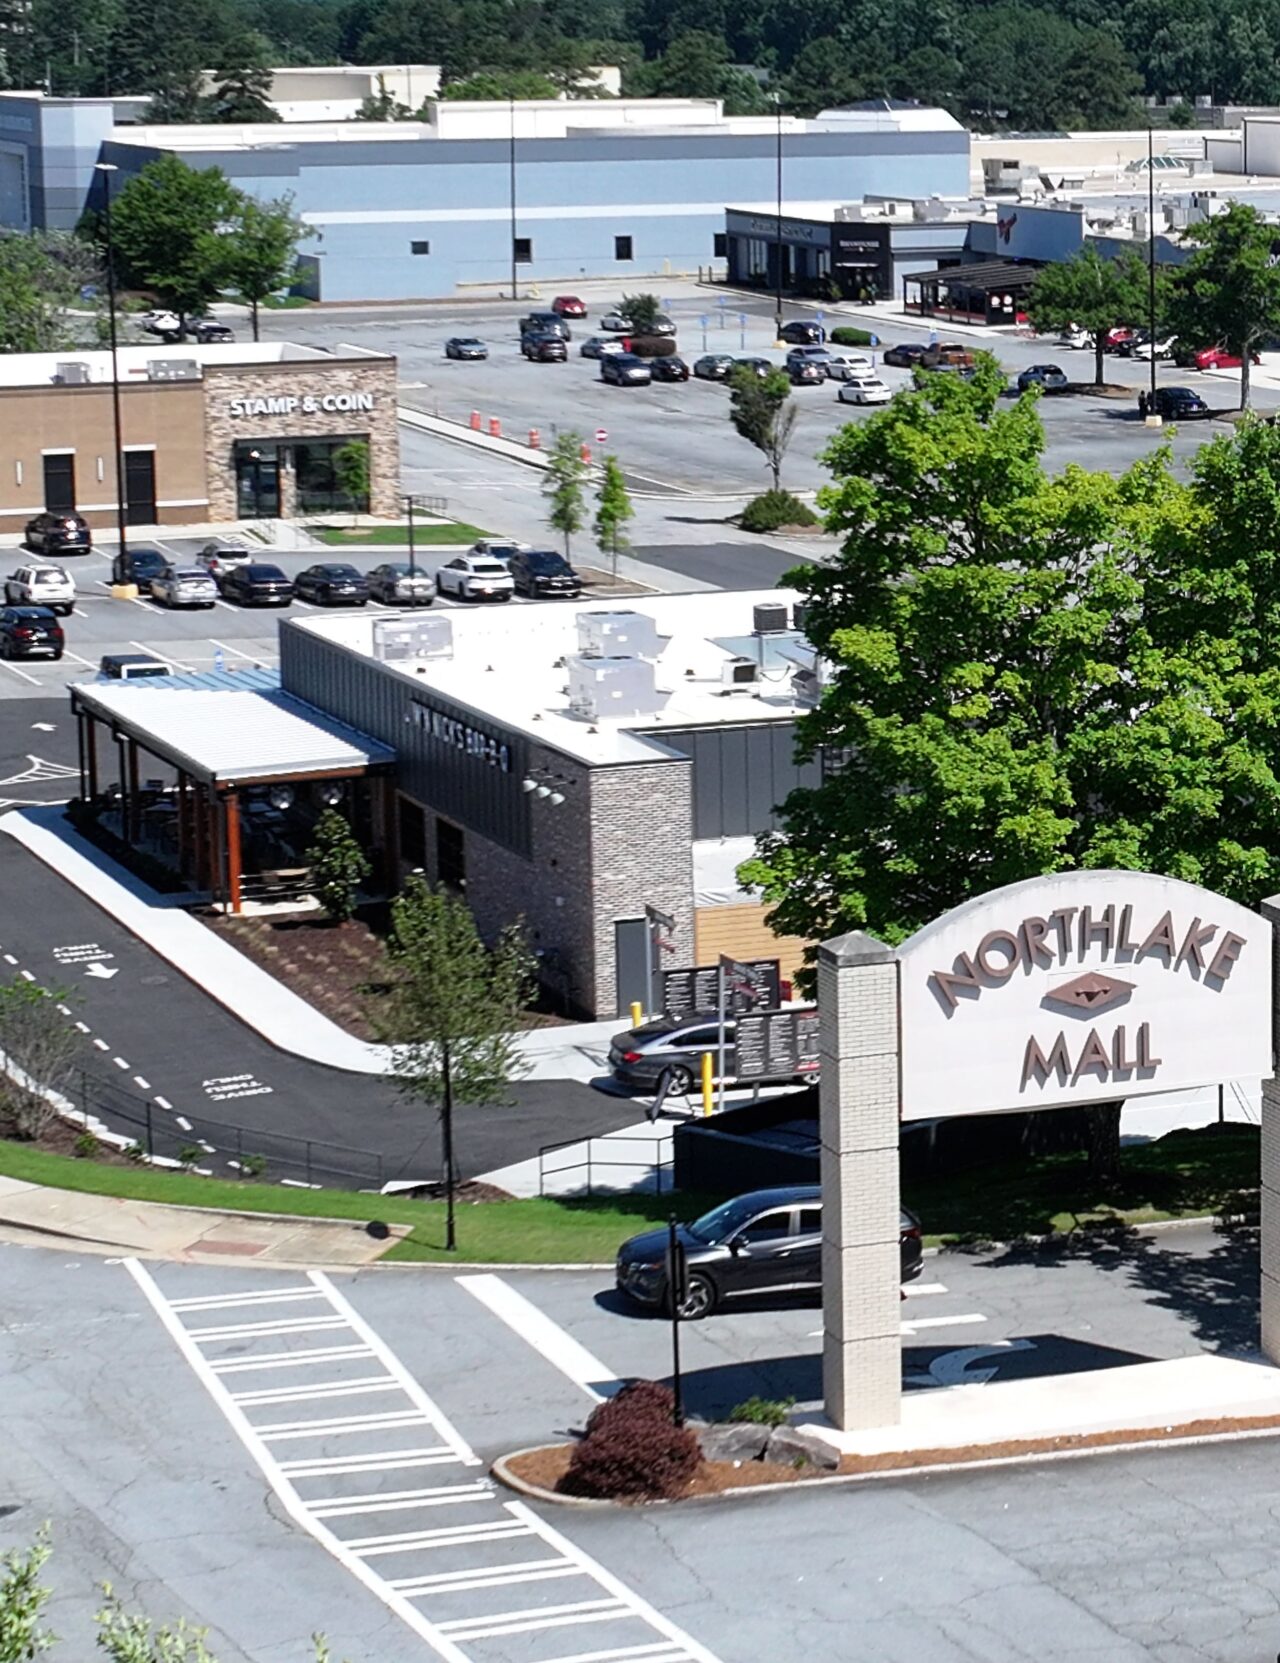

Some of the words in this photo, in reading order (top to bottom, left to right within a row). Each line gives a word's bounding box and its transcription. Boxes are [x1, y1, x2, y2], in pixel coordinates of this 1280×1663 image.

[230, 397, 299, 415] STAMP
[302, 396, 318, 412] &
[322, 393, 374, 411] COIN
[929, 903, 1248, 1009] NORTHLAKE
[1021, 1021, 1163, 1089] MALL
